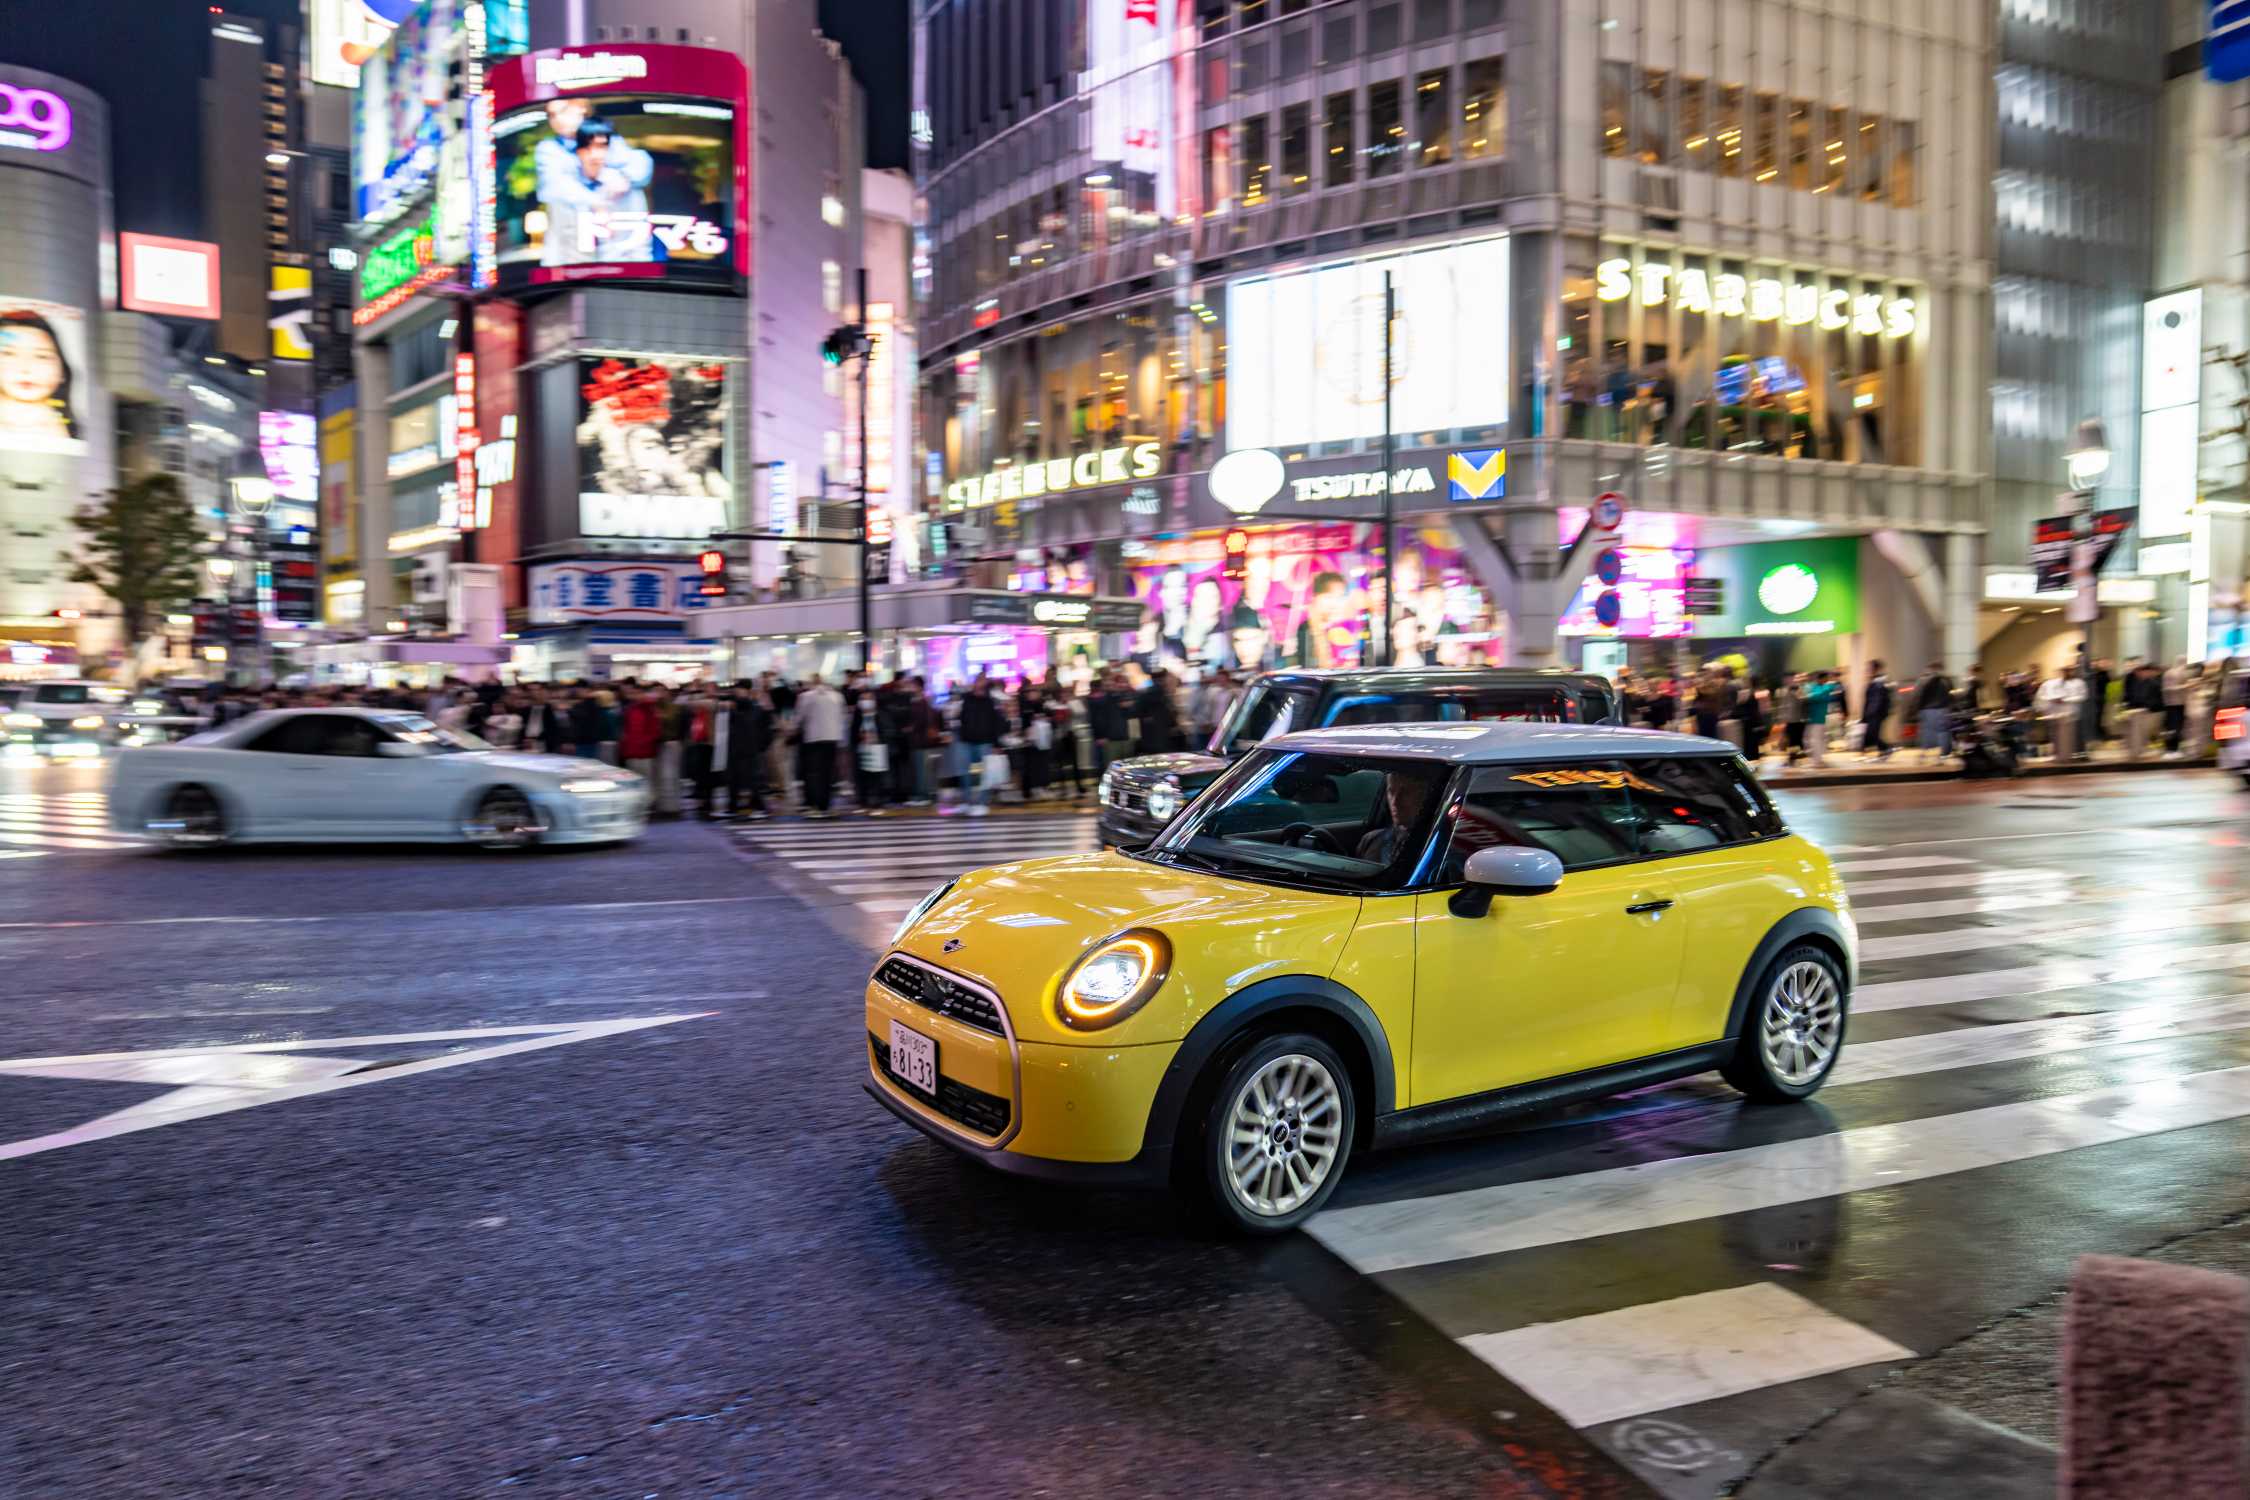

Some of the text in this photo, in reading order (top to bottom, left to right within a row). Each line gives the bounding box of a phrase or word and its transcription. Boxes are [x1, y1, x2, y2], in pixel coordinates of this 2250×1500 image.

[577, 211, 728, 254] ドラマも
[1597, 258, 1915, 338] STARBUCKS
[948, 442, 1160, 512] STARBUCKS
[1290, 467, 1436, 501] TSUTAYA
[899, 1047, 932, 1088] 81-33
